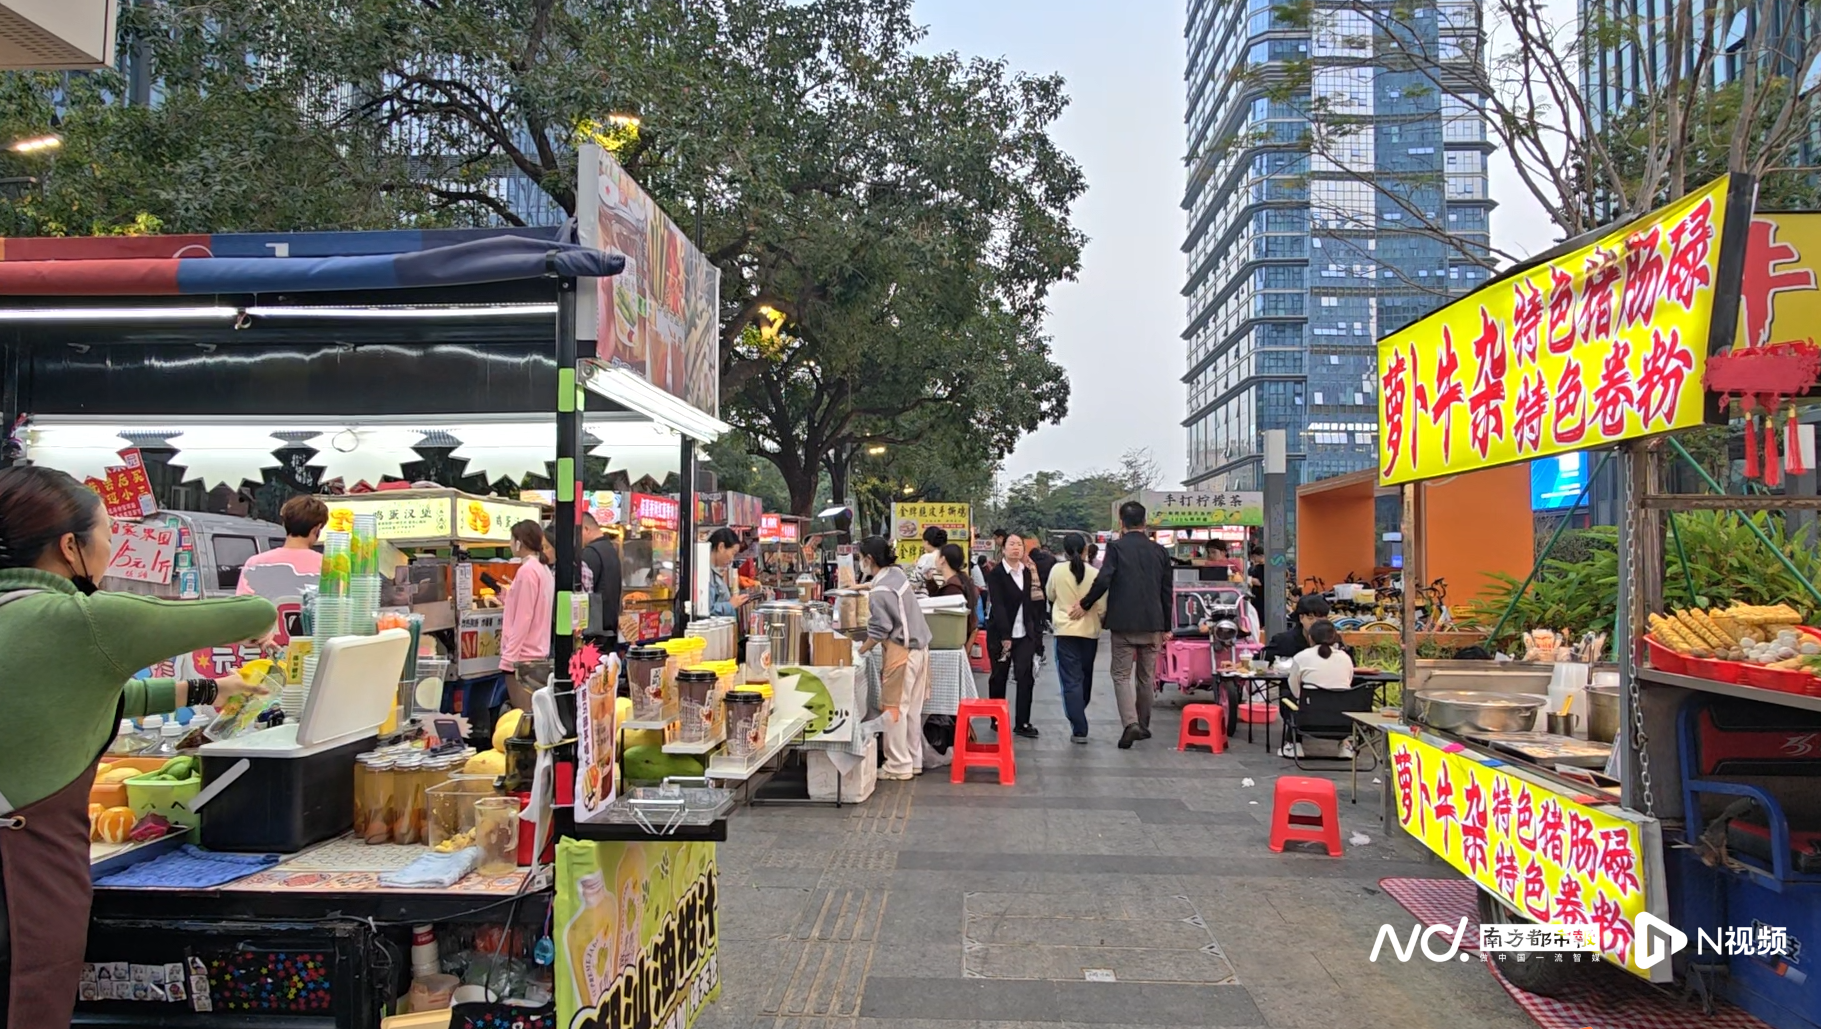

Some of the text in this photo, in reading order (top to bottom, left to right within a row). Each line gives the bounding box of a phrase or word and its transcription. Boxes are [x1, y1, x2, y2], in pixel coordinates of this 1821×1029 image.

[1512, 198, 1713, 368] 特色猪肠碌
[1384, 306, 1507, 478] 萝卜牛杂
[1512, 329, 1693, 453] 特色卷粉
[1163, 493, 1243, 508] 手打柠檬茶
[1393, 744, 1488, 875] 萝卜牛杂
[1491, 774, 1641, 897] 特色猪肠碌
